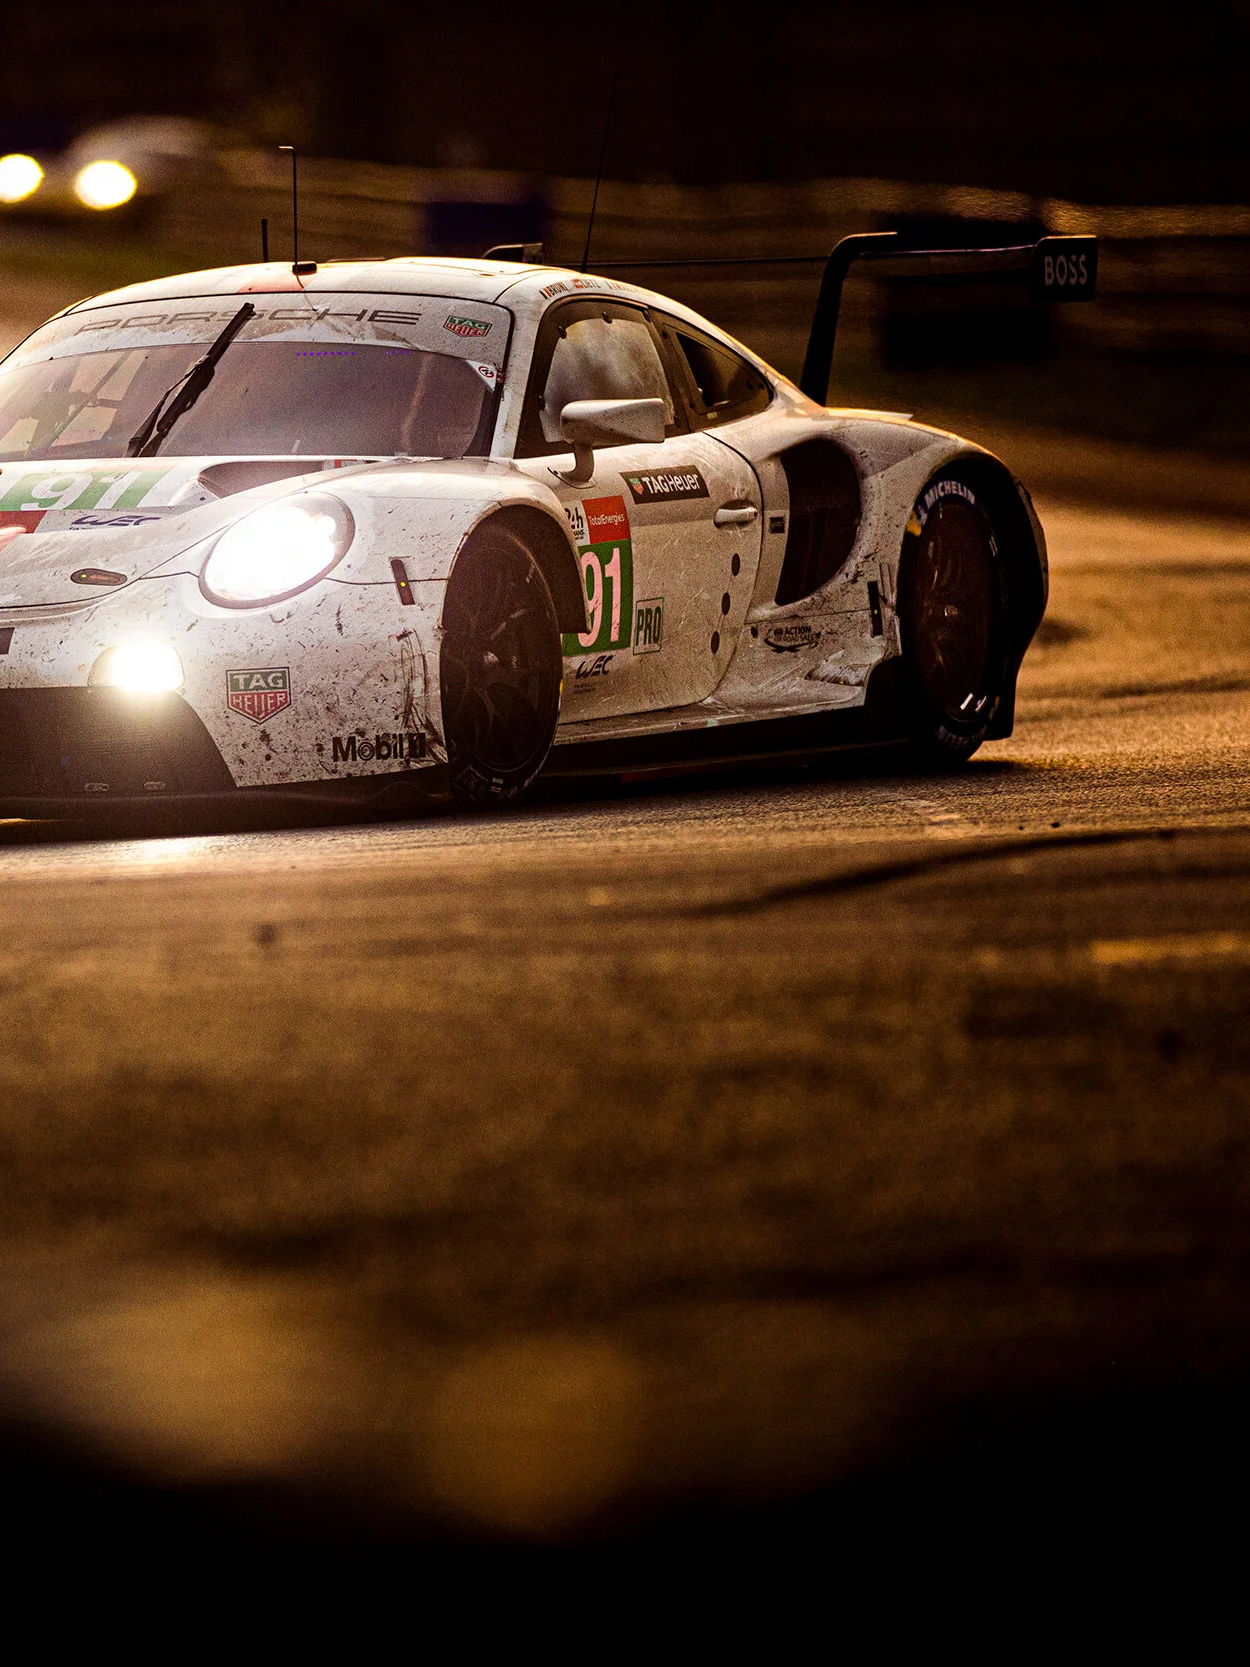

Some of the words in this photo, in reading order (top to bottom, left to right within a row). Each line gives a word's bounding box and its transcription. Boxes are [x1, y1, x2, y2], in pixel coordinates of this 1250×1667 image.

[1044, 254, 1088, 286] BOSS
[452, 317, 487, 330] TAG
[20, 471, 140, 511] 91
[924, 480, 976, 509] MICHELIN
[588, 513, 625, 527] TotalEnergies
[576, 547, 621, 648] 91
[635, 605, 662, 647] PRO
[232, 673, 284, 689] TAG
[575, 655, 614, 680] WEC
[232, 692, 286, 720] HEUER
[332, 733, 404, 763] Mobil
